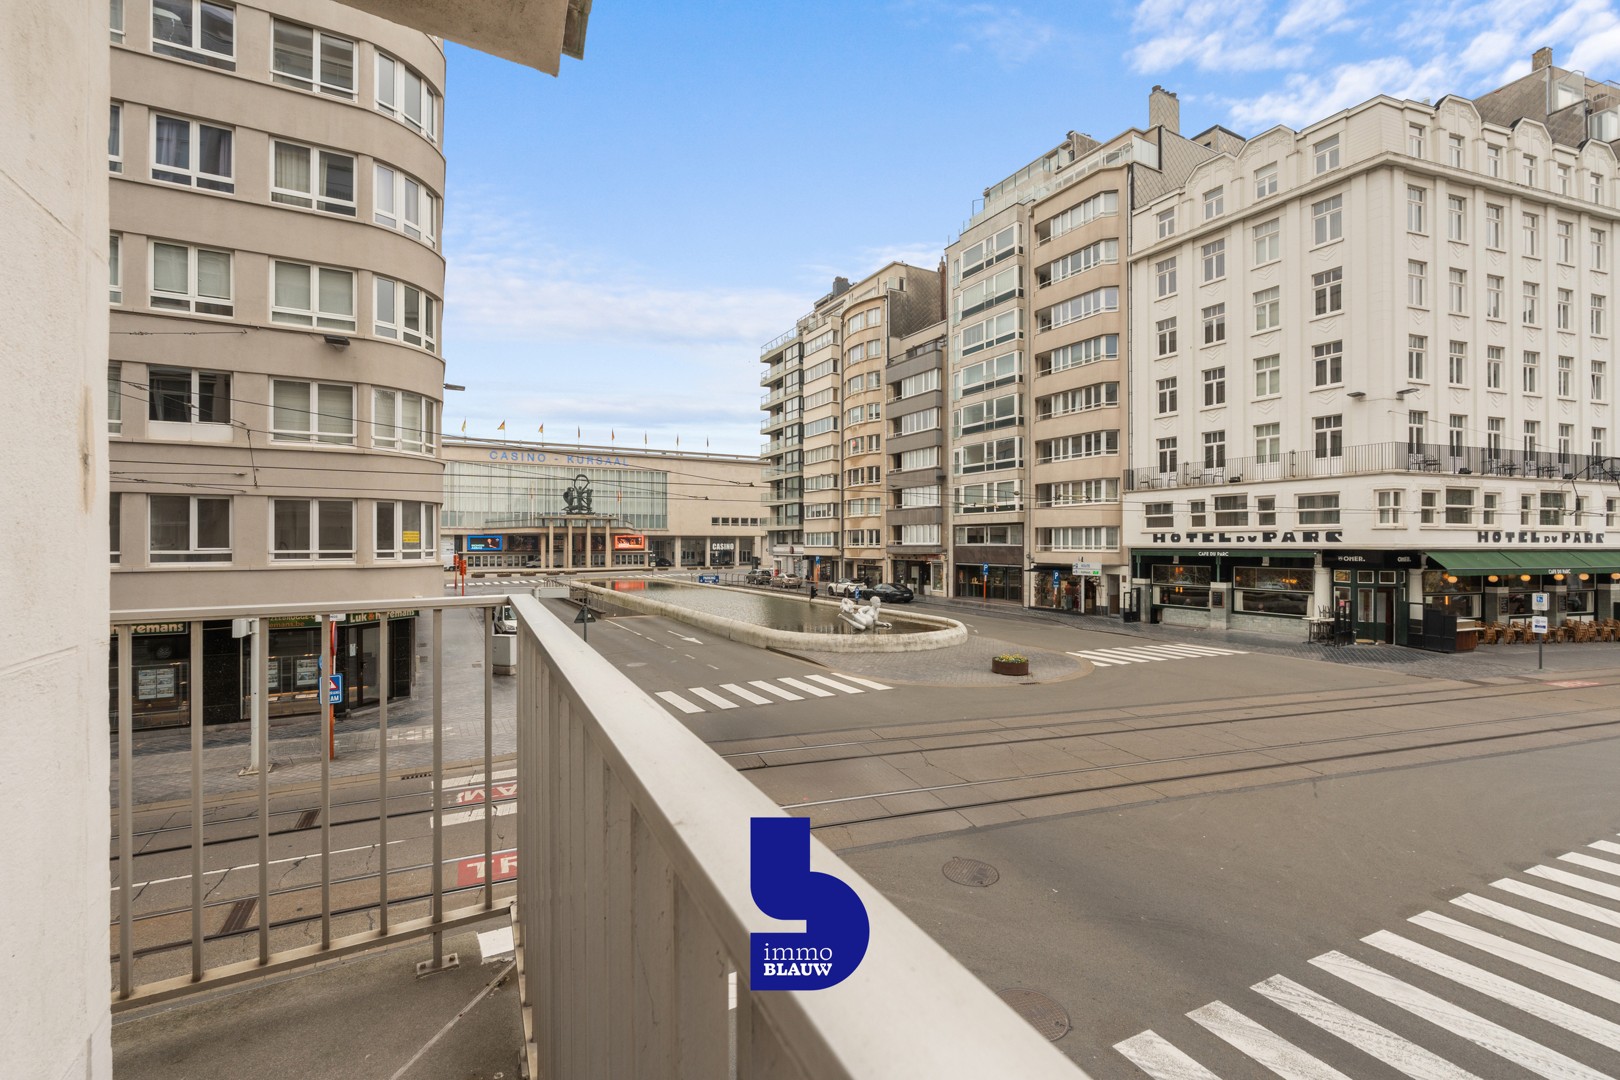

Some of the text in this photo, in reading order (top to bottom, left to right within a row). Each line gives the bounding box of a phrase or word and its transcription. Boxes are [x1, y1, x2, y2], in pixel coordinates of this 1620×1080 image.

[489, 450, 546, 463] CASINO
[567, 455, 629, 467] KURSAAL
[1153, 532, 1231, 543] HOTEL
[1236, 535, 1257, 543] DU
[1477, 531, 1540, 543] HOTEL
[1544, 535, 1558, 543] DU
[350, 613, 367, 622] Luk
